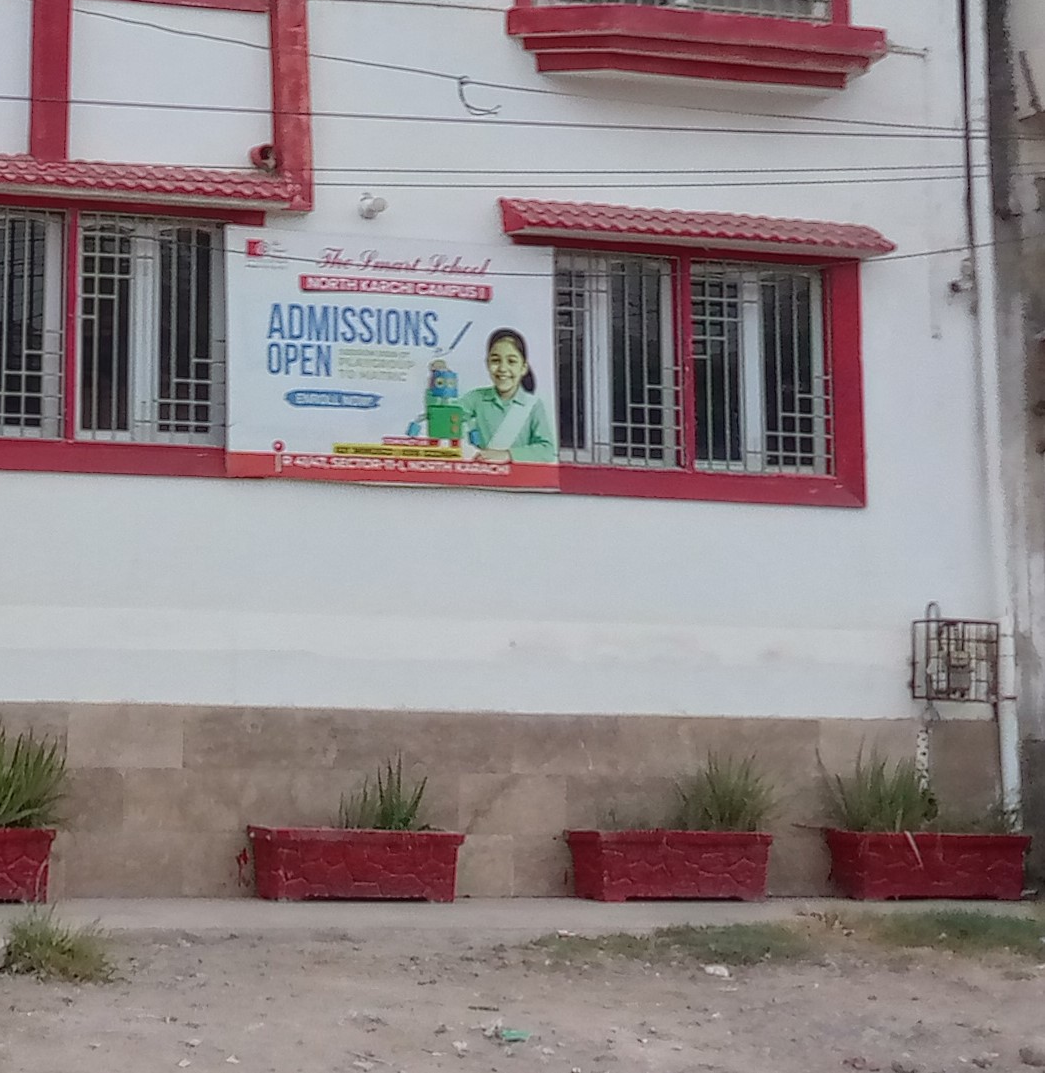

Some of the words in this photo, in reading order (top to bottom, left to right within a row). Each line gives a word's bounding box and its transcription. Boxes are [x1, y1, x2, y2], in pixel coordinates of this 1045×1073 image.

[316, 247, 354, 269] The
[359, 249, 422, 272] Smart
[428, 253, 492, 276] School
[307, 278, 357, 291] NORTH
[415, 283, 478, 298] CAMPUS
[267, 303, 438, 347] ADMISSIONS
[268, 342, 331, 377] OPEN
